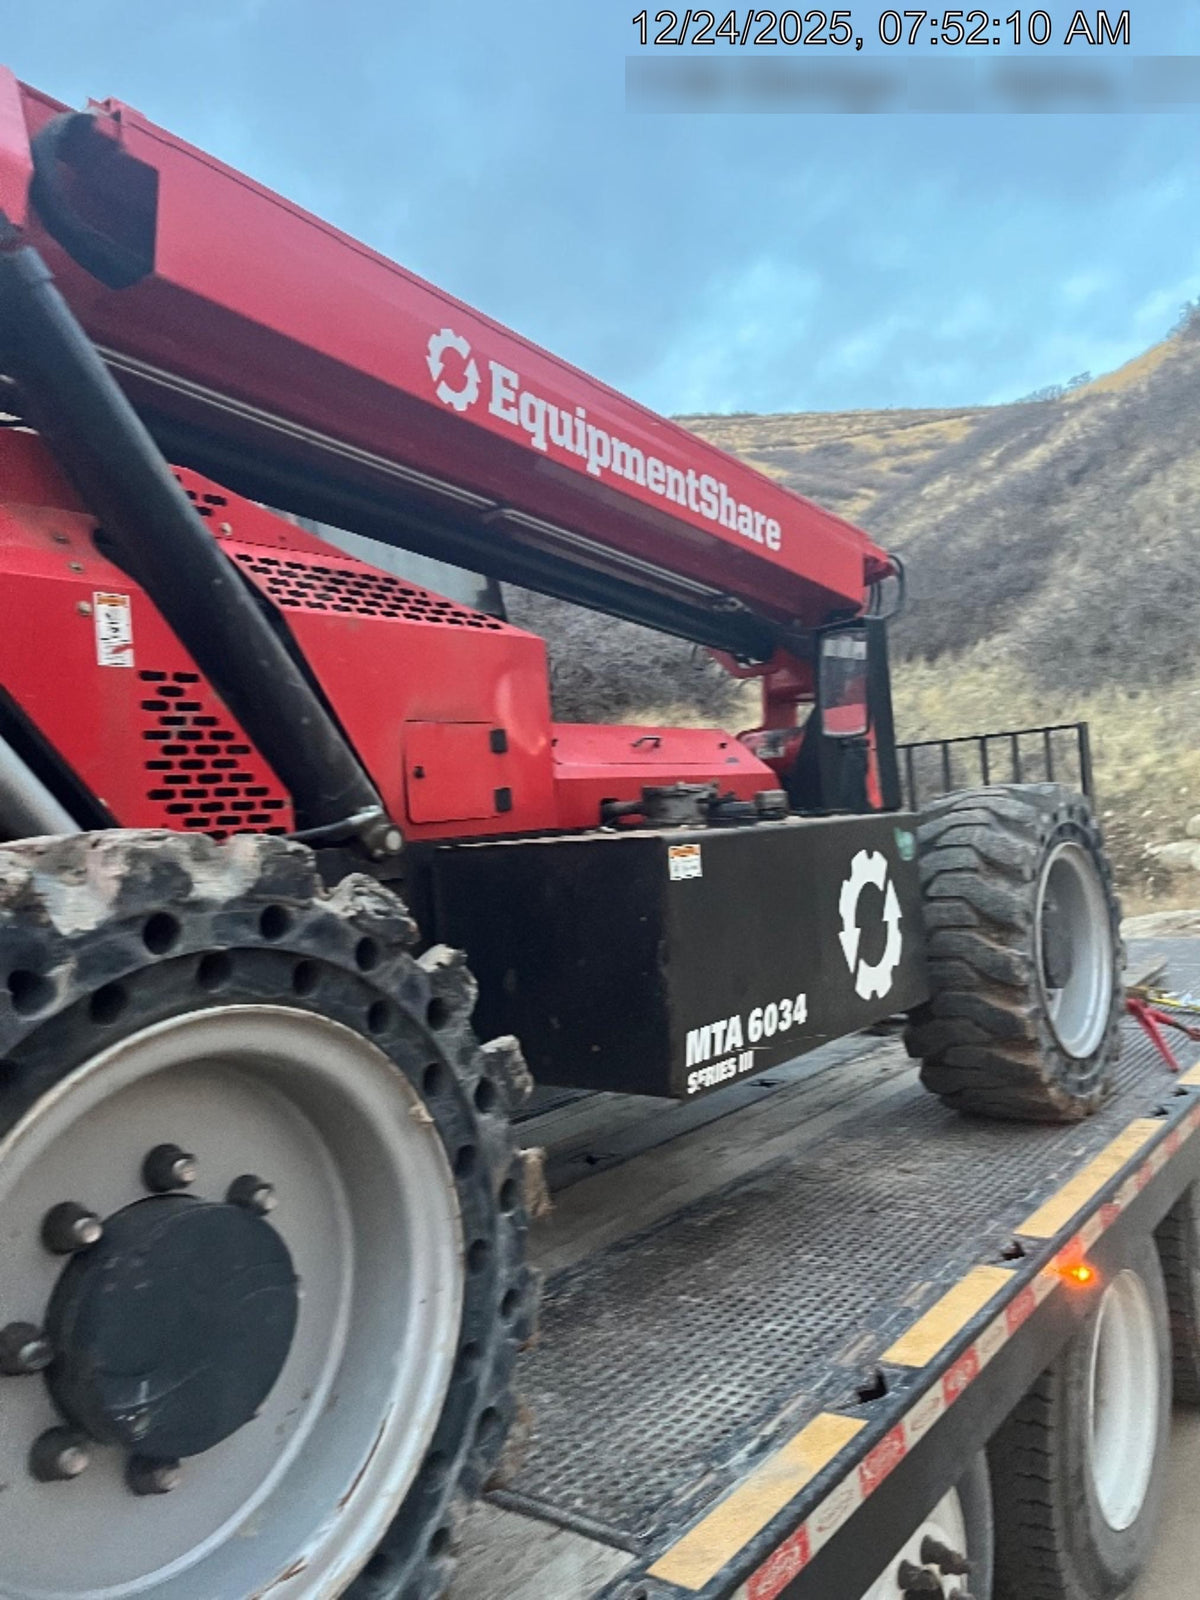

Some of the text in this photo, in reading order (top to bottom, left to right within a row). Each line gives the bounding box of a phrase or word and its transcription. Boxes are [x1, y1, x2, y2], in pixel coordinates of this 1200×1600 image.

[488, 360, 781, 551] EquipmentShare
[686, 993, 808, 1067] MTA 6034
[687, 1050, 754, 1094] SERIES III
